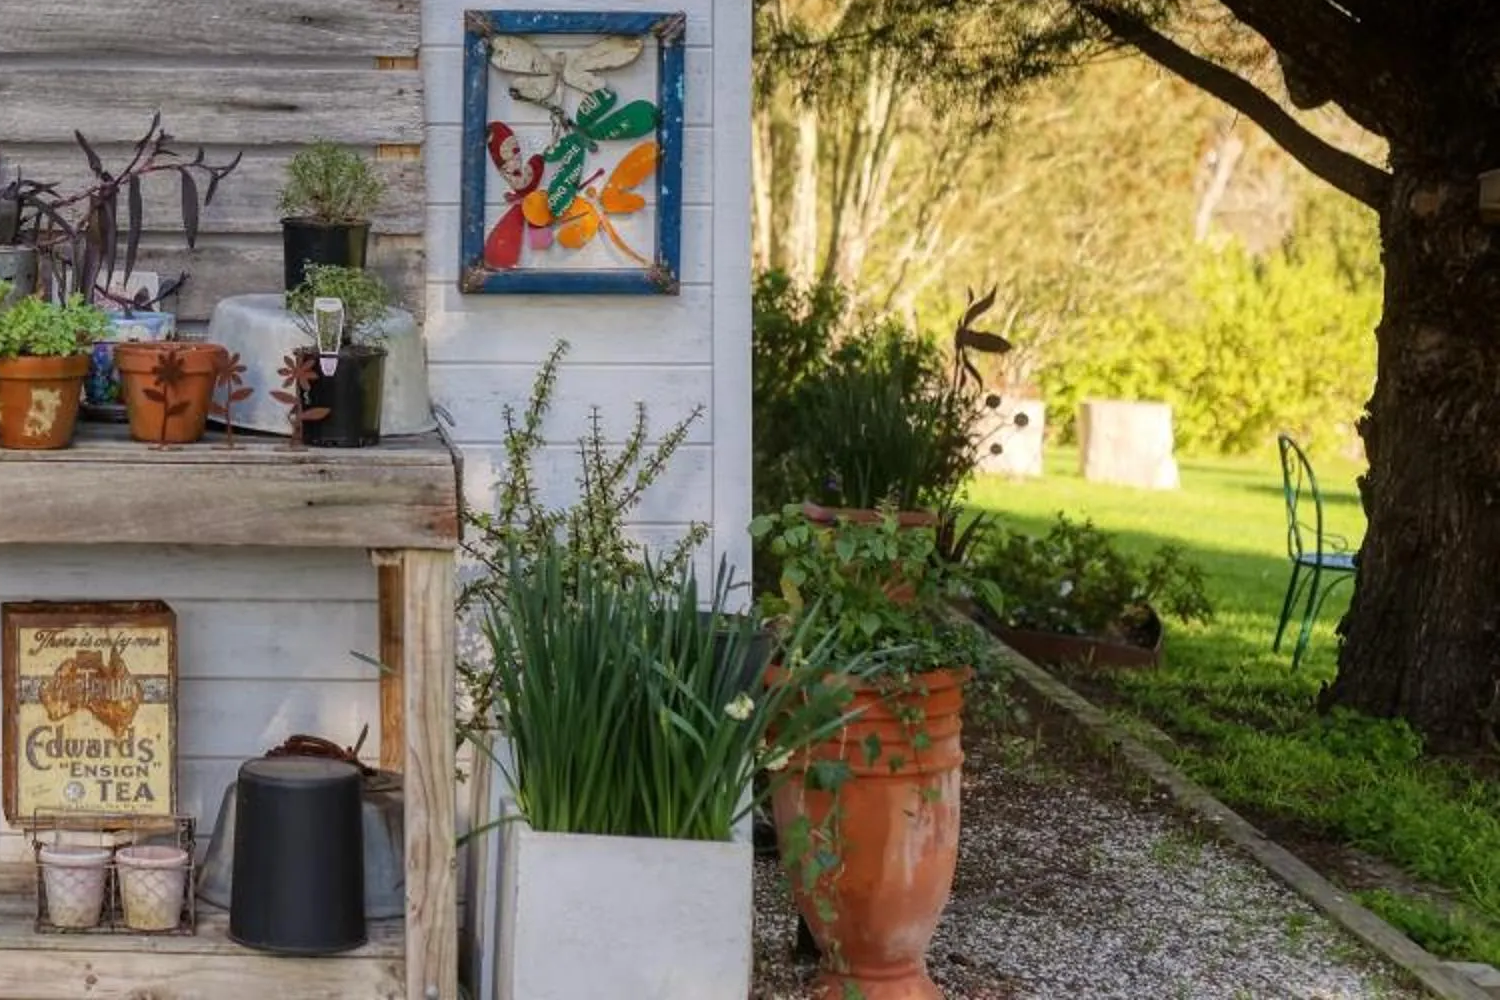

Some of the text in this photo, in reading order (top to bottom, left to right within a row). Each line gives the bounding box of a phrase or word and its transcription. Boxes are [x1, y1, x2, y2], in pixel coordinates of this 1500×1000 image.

[28, 630, 77, 656] There
[80, 631, 93, 647] is
[94, 631, 132, 654] only
[60, 761, 162, 778] "ENSIGN"
[95, 779, 155, 801] TEA
